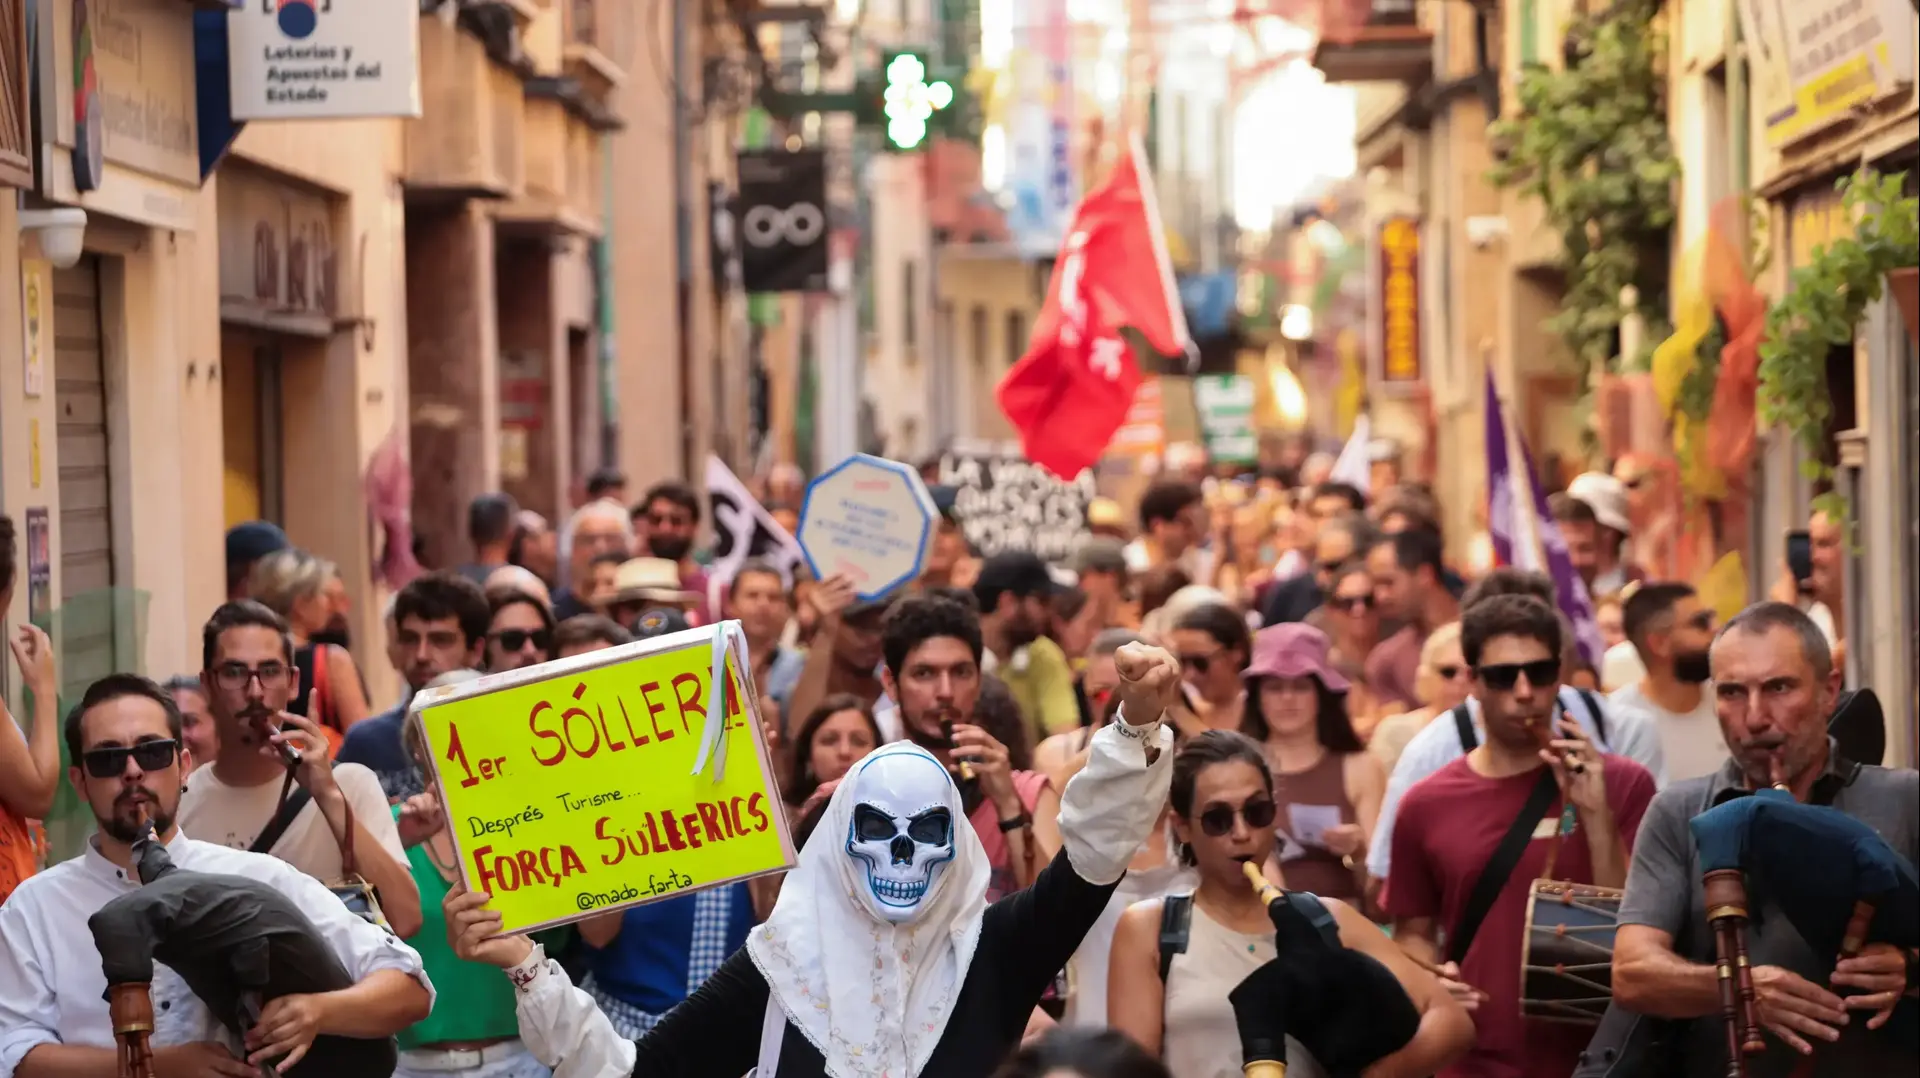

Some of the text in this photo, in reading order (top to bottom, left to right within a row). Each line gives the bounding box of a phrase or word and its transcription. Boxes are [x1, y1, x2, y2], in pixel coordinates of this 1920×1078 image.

[467, 805, 545, 838] Després
[472, 844, 588, 899] FORÇA
[576, 868, 693, 911] @mado_farta
